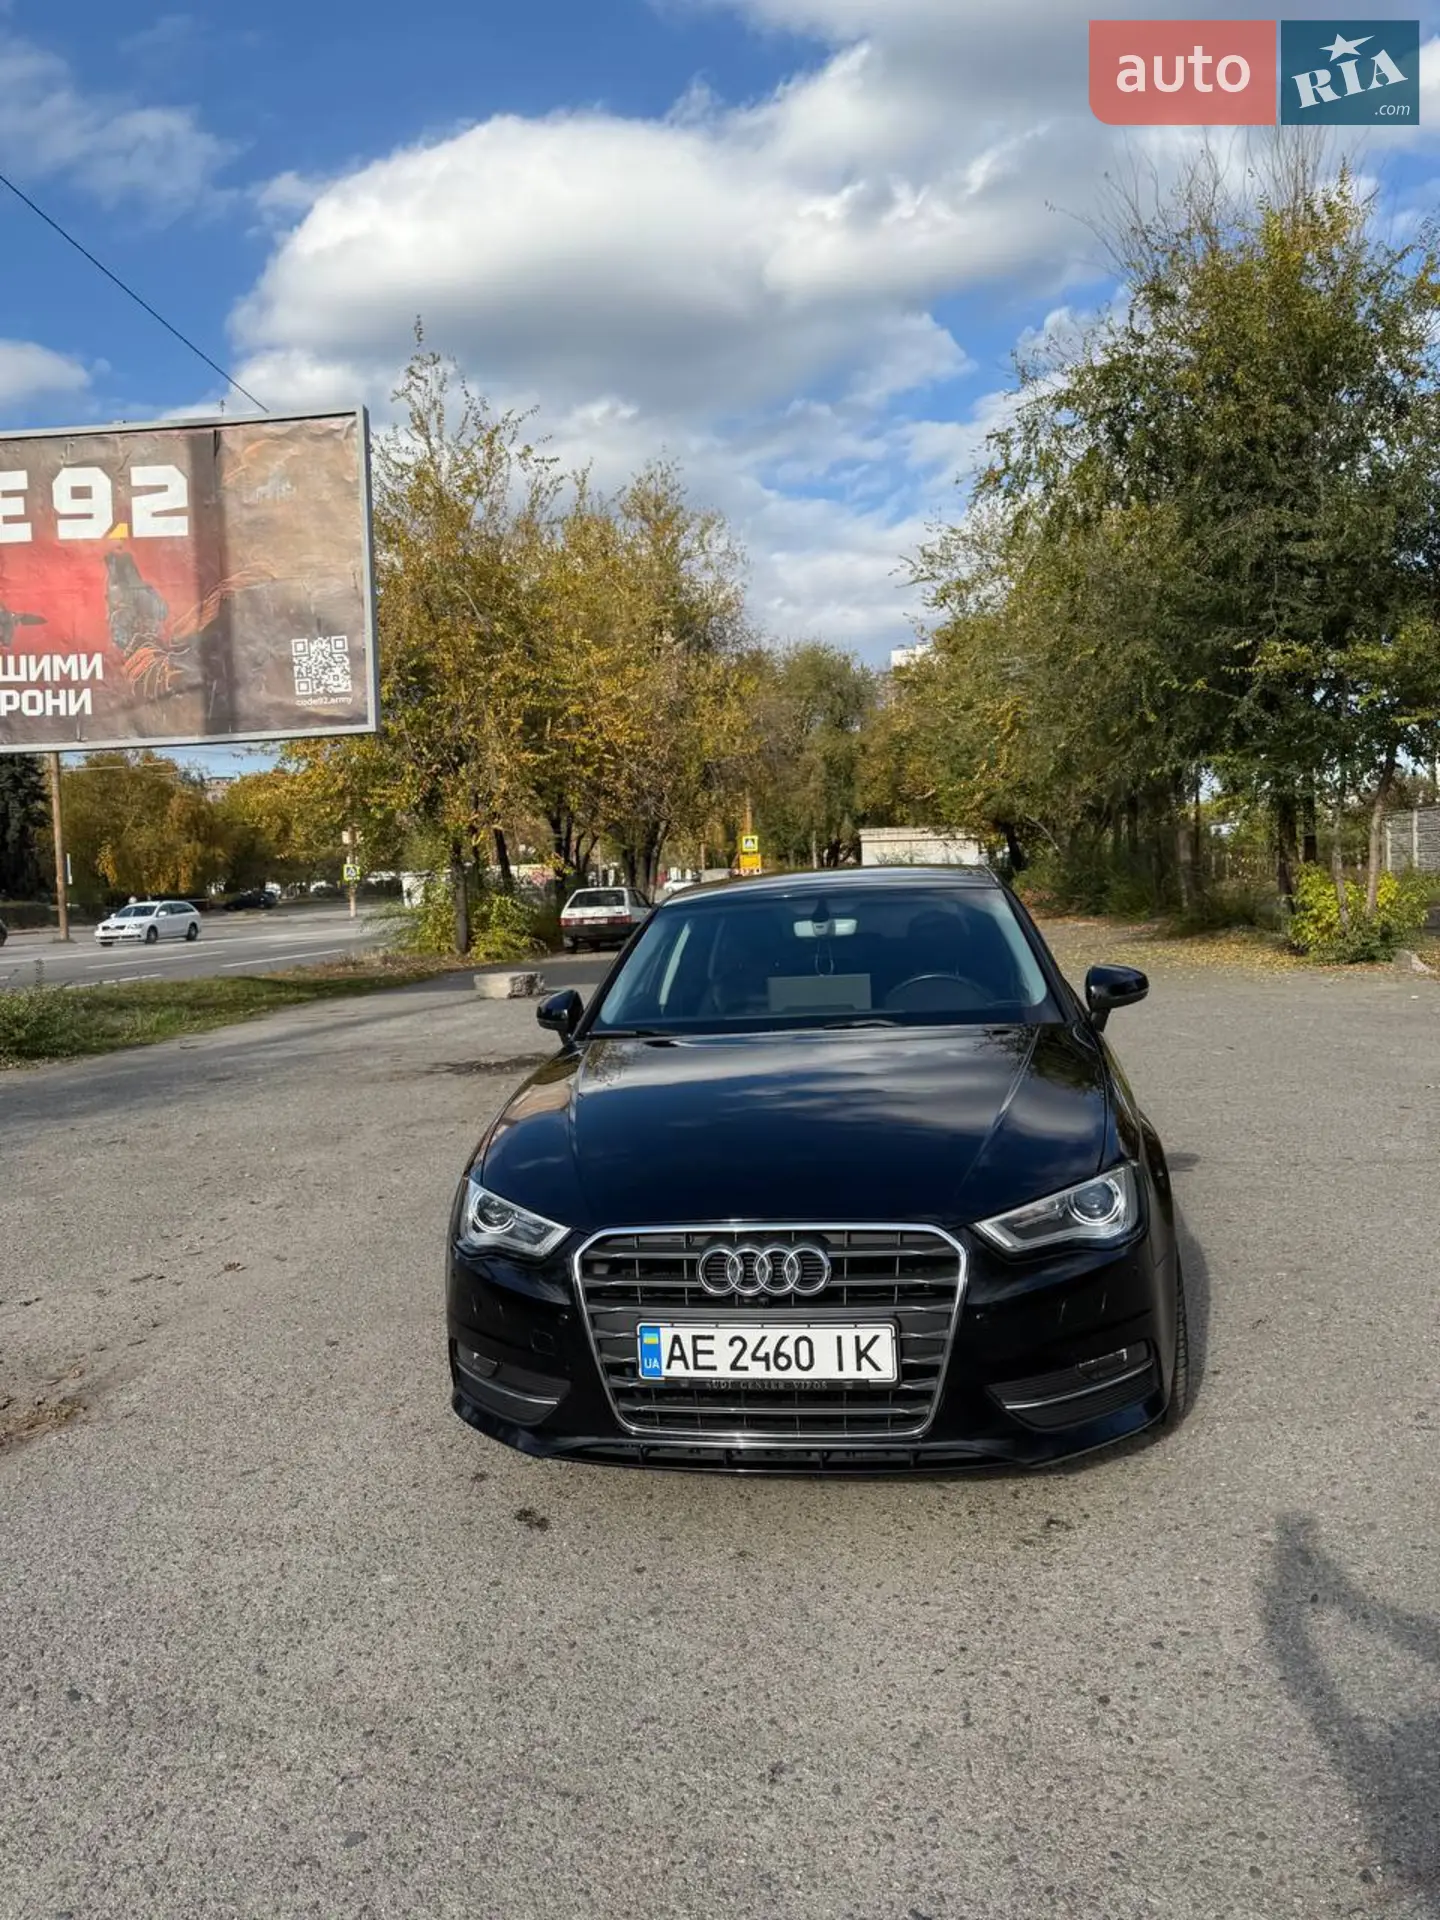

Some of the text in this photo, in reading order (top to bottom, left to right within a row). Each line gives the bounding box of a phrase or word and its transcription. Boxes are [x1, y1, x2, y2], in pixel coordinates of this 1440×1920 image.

[0, 688, 92, 716] РОНИ
[644, 1357, 660, 1369] UA
[666, 1334, 882, 1372] AE 2460 IK
